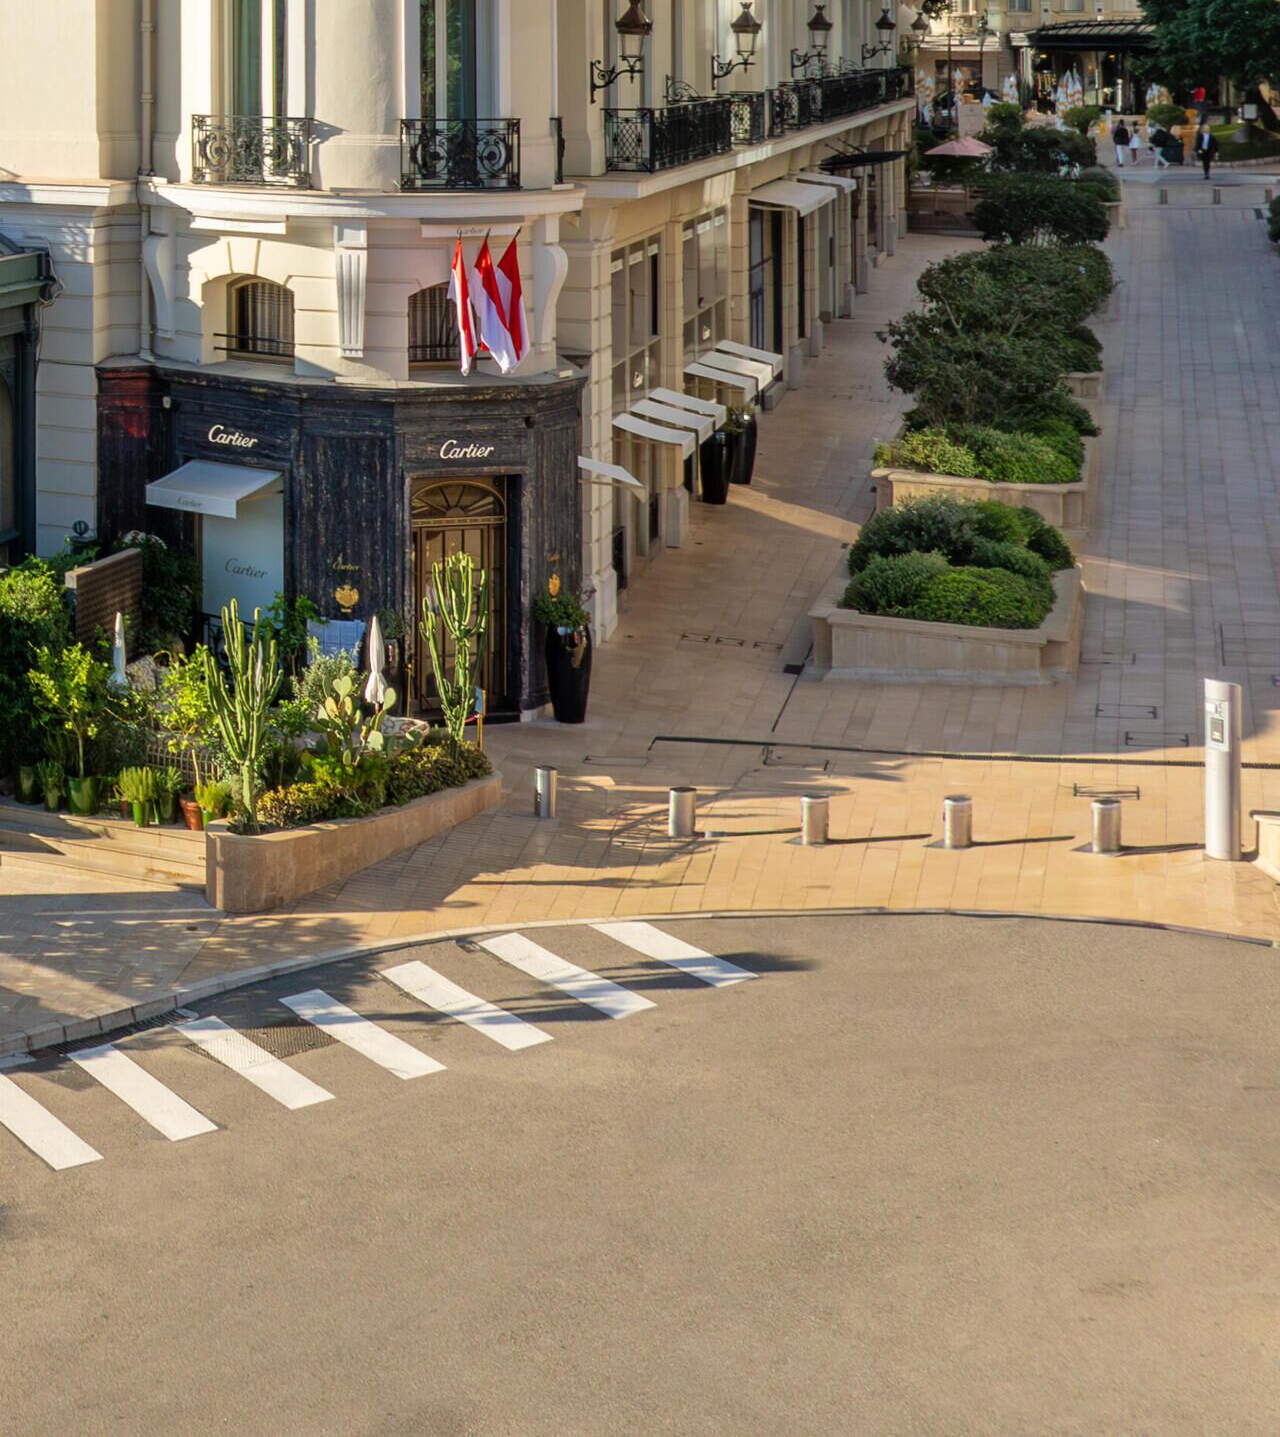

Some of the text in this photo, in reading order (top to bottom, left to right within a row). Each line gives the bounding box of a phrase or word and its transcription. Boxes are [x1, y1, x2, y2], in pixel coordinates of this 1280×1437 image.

[208, 424, 258, 449] Cartier
[439, 439, 495, 460] Cartier
[177, 496, 204, 509] Cartier
[224, 558, 269, 580] Cartier
